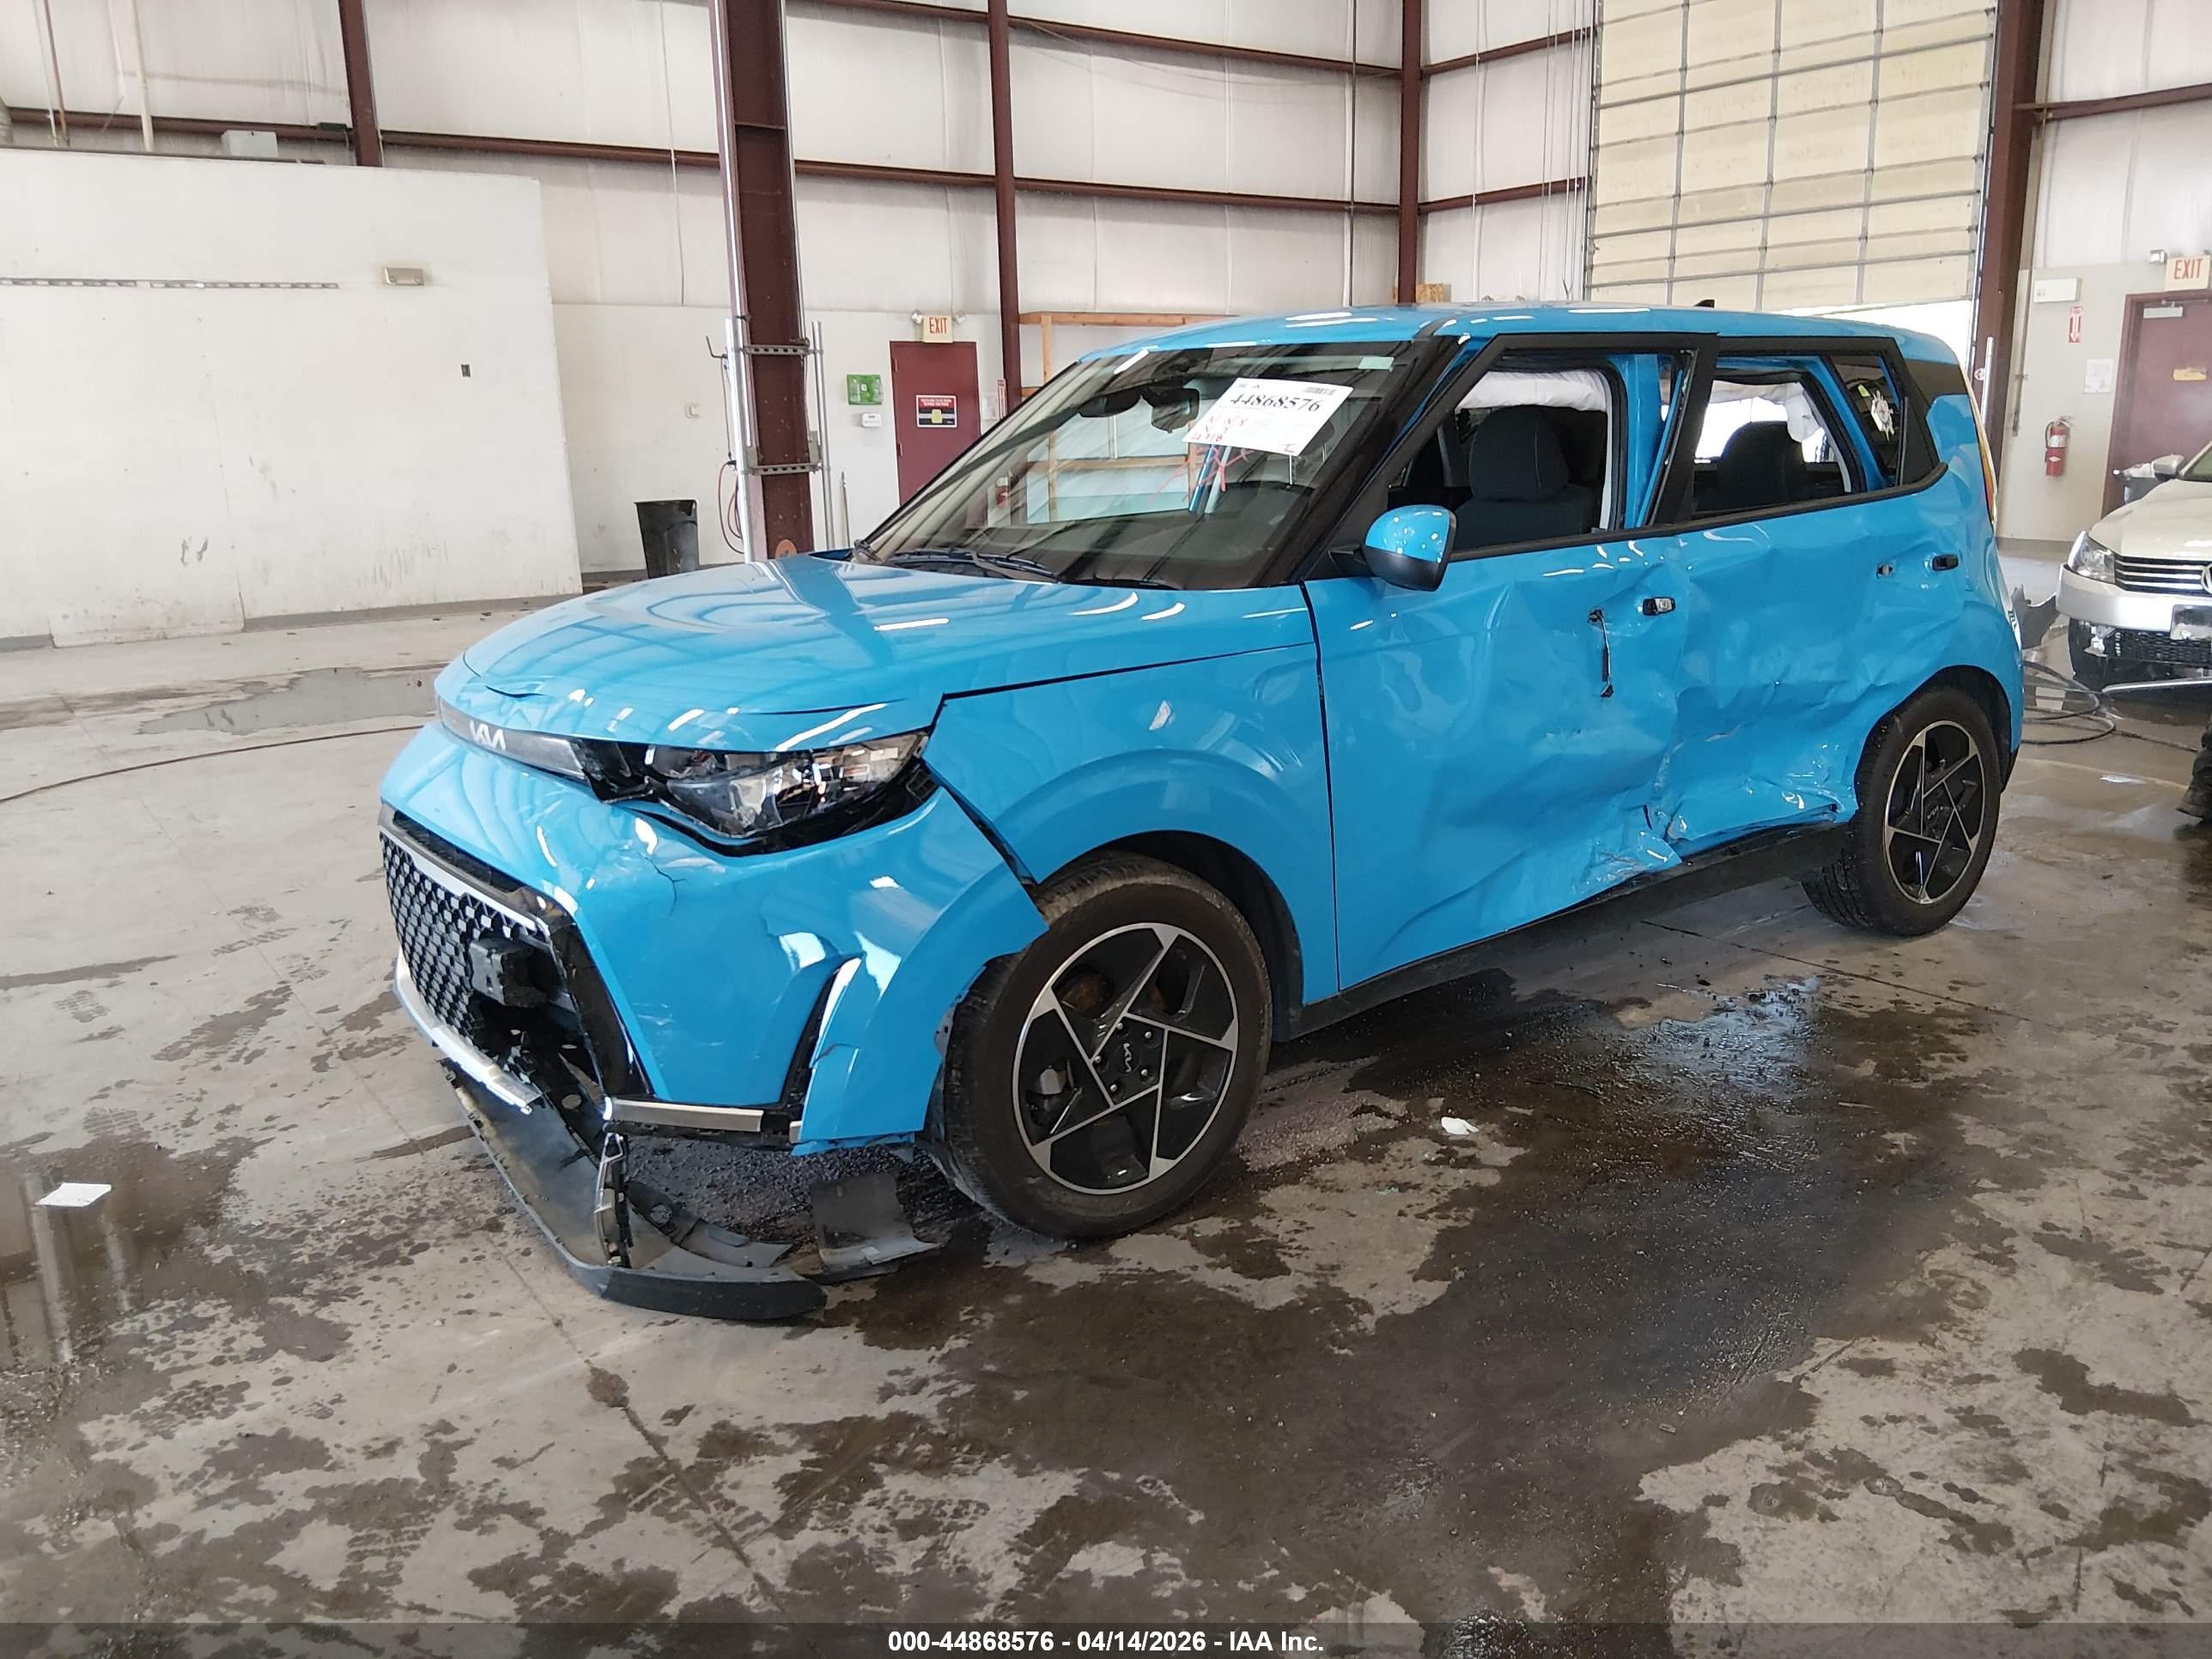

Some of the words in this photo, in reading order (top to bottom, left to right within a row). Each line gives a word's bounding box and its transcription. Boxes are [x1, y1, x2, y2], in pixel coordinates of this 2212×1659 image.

[2173, 258, 2203, 280] EXIT
[929, 317, 948, 334] EXIT
[1230, 393, 1322, 412] 44868576
[470, 720, 506, 750] KIA
